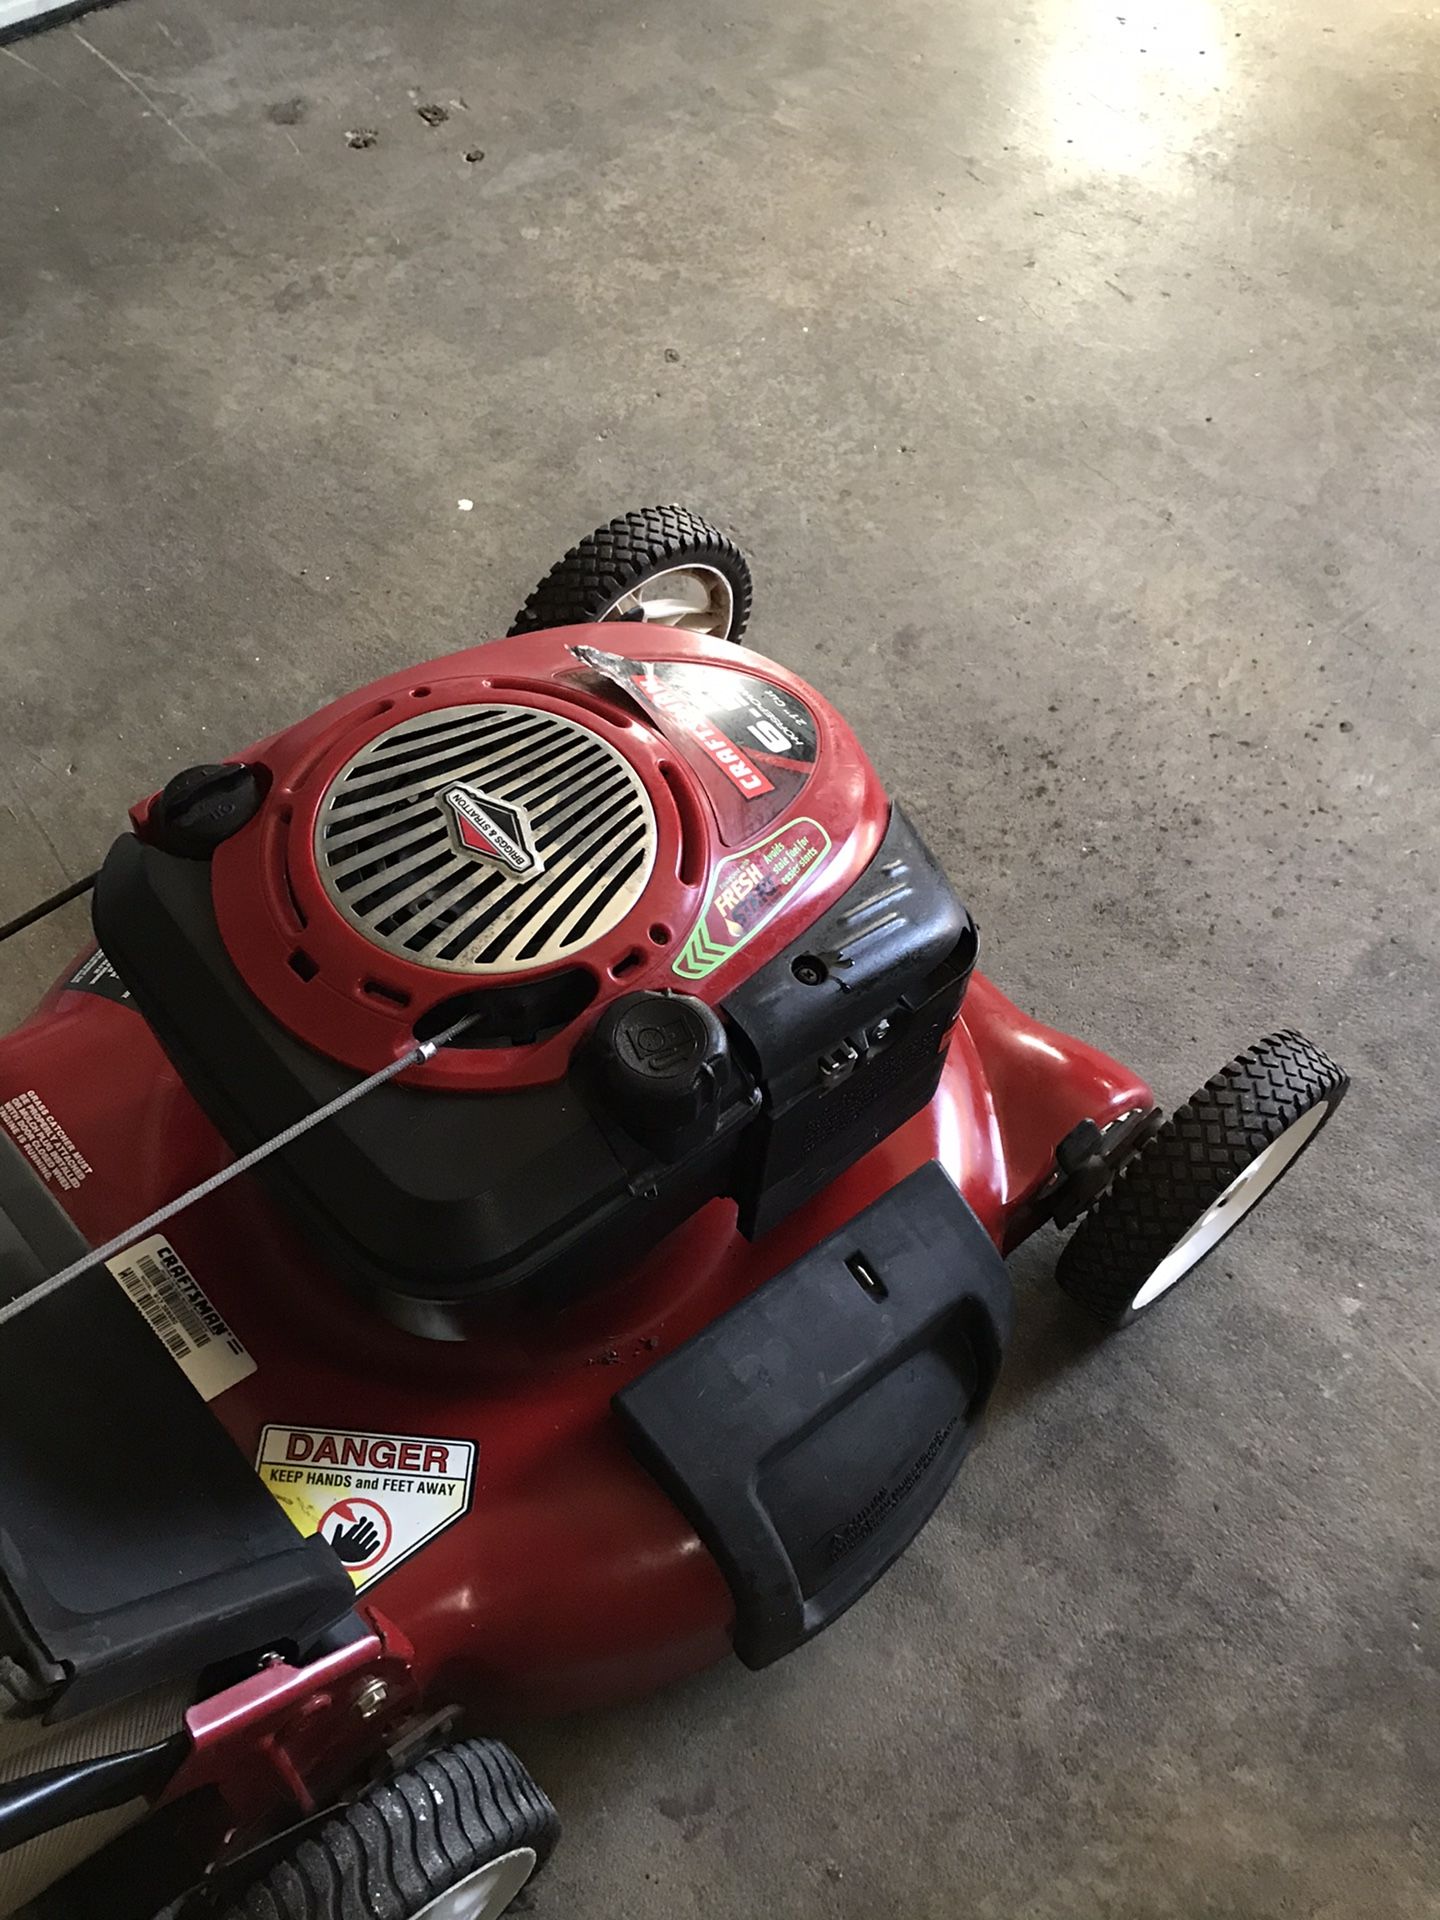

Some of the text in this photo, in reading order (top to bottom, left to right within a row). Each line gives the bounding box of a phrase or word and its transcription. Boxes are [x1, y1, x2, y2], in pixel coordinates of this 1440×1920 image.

[640, 674, 763, 790] CRAFTAN
[733, 682, 804, 746] HORSEPOW
[452, 793, 526, 866] BRIGGS & STRATTON
[762, 841, 785, 864] Avoids
[785, 842, 801, 861] fuel
[797, 834, 810, 851] for
[713, 863, 764, 917] FRESH
[780, 846, 818, 885] easier starts
[4, 1103, 70, 1189] WITH DOOR CLOSED WHEN
[12, 1098, 80, 1188] OR MULCH PLUG INSTALLED
[17, 1135, 26, 1143] IS
[19, 1094, 85, 1180] BE PROPERLY ATTACHED
[28, 1090, 92, 1173] GRASS CATCHER MUST
[157, 1246, 228, 1334] CRAFTSMAN
[270, 1468, 456, 1496] KEEP HANDS and FEET AWAY
[286, 1433, 449, 1474] DANGER
